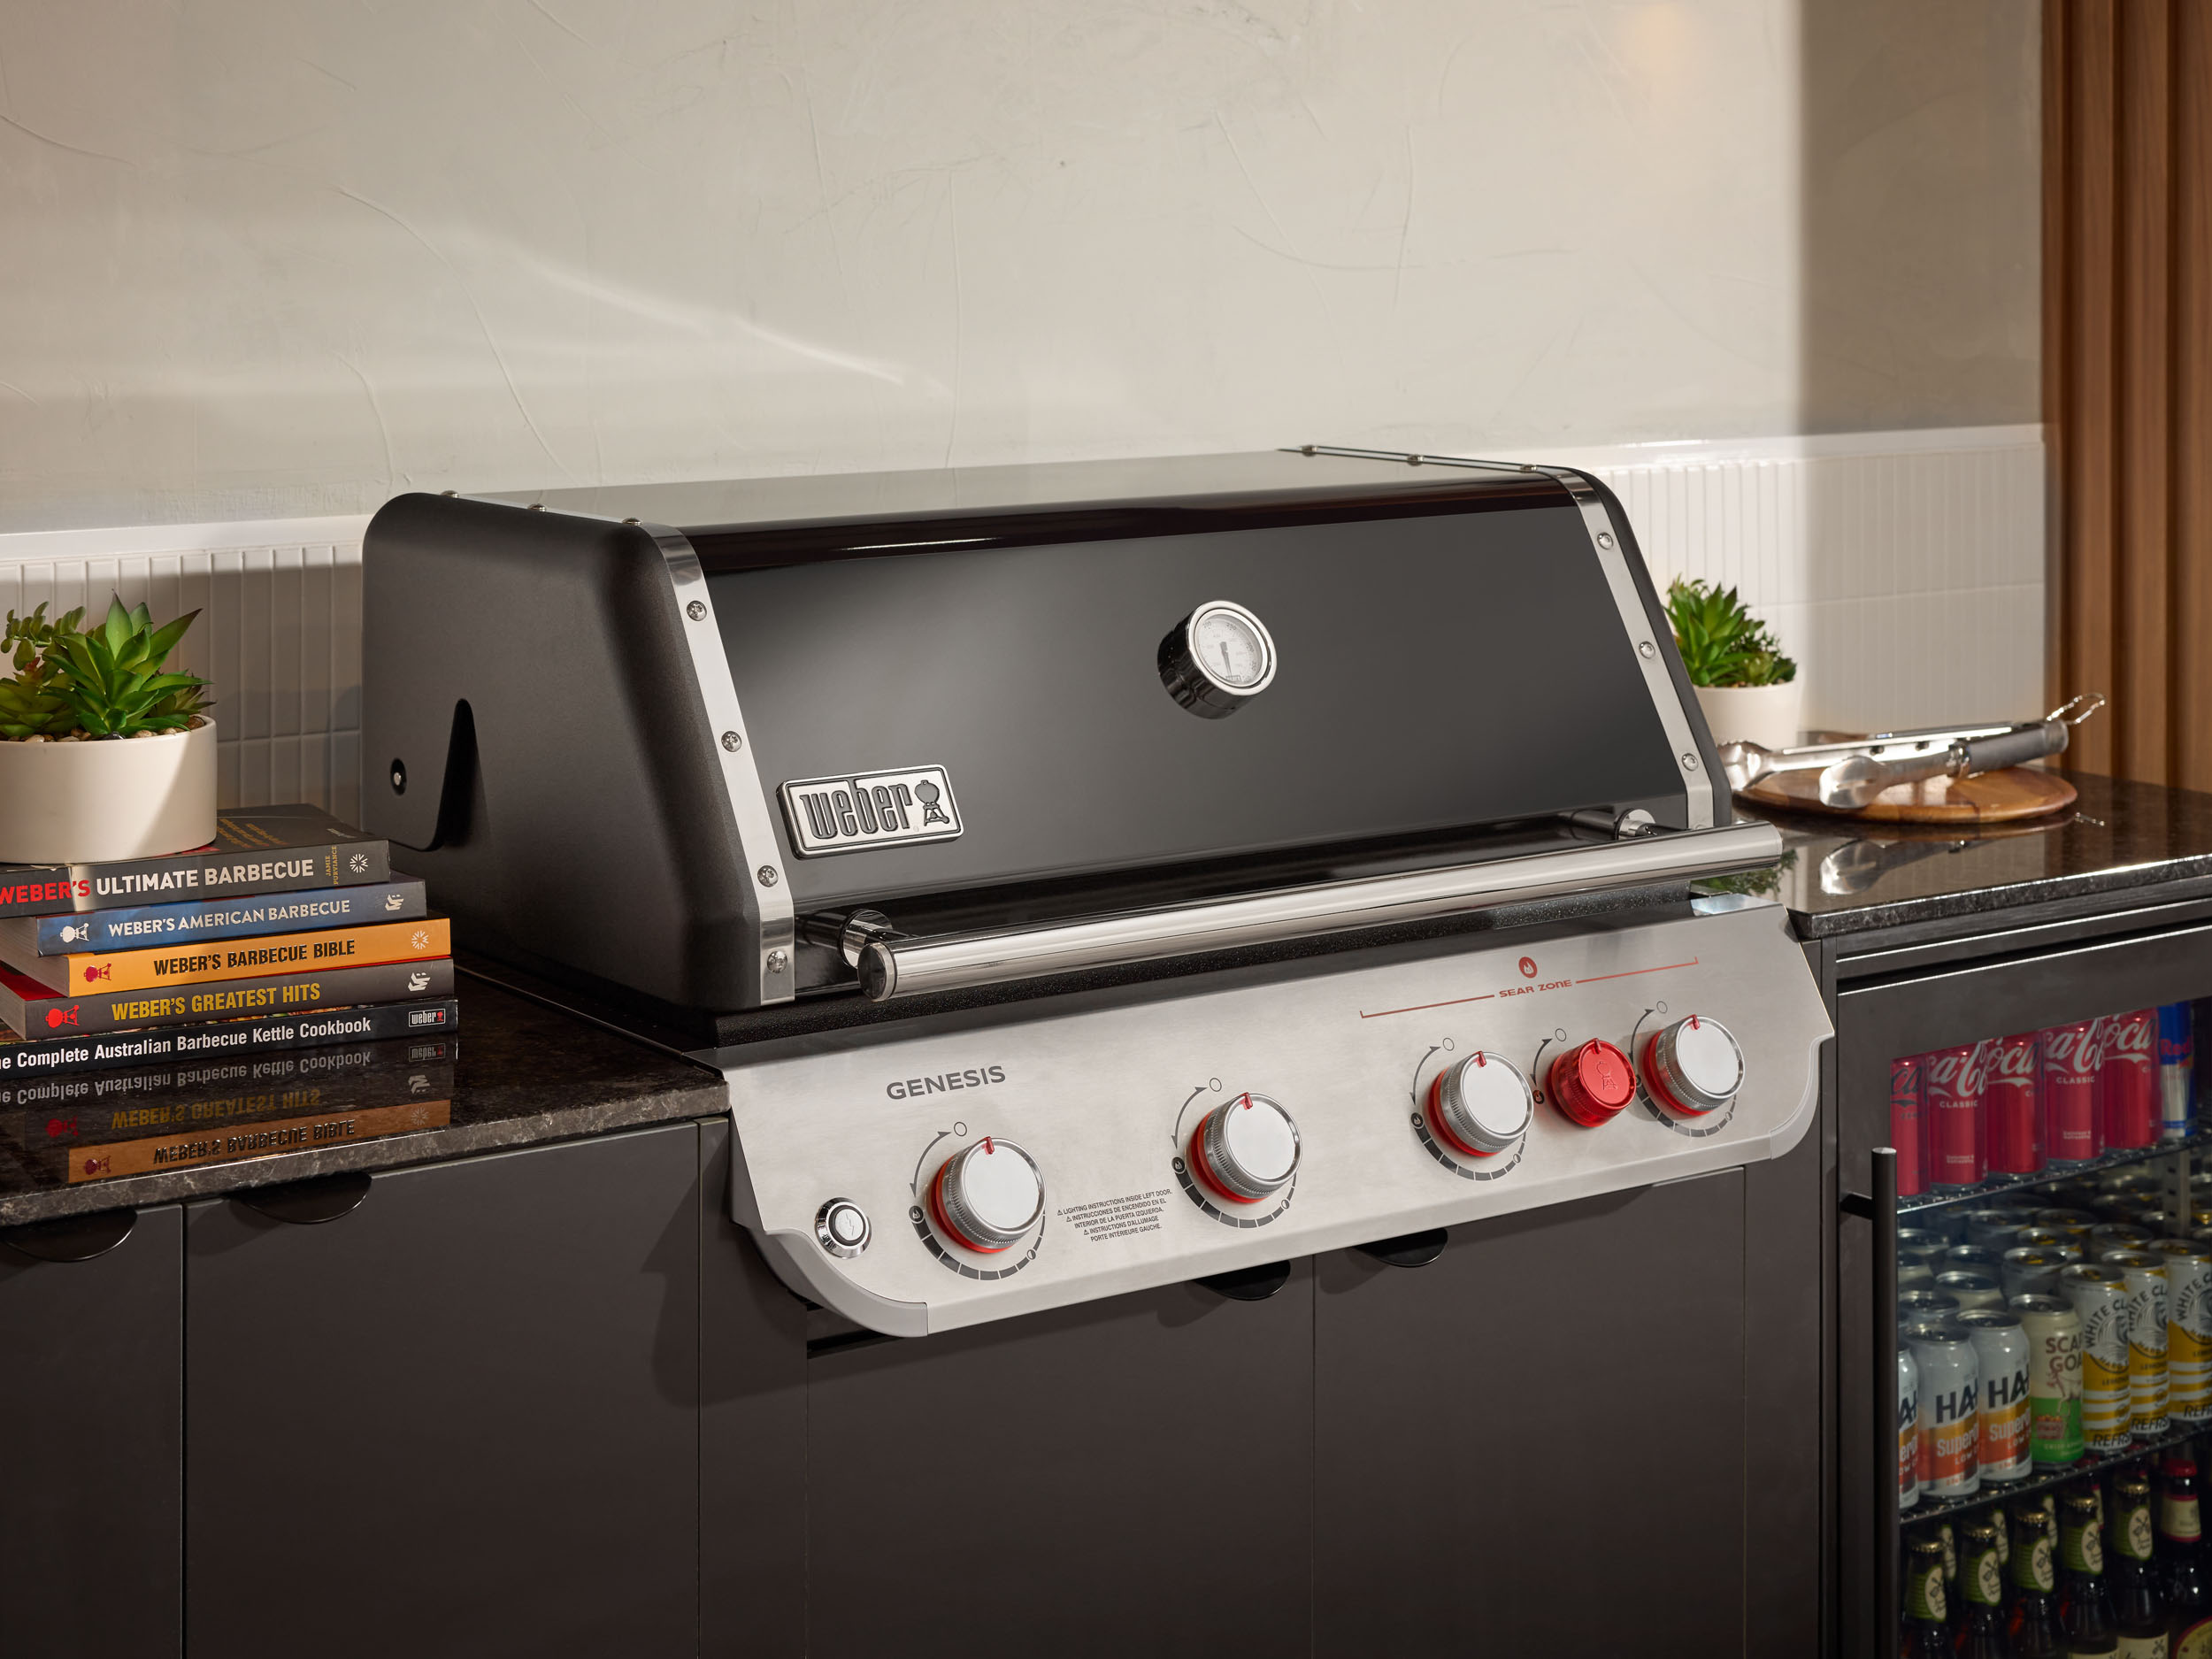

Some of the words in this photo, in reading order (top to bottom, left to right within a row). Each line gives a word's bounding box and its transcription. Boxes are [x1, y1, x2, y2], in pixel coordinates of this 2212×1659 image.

[799, 779, 913, 839] weber
[0, 879, 90, 905] WEBER'S
[96, 868, 199, 895] ULTIMATE
[205, 859, 313, 885] BARBECUE
[108, 918, 175, 937] WEBER'S
[178, 909, 264, 930] AMERICAN
[268, 899, 350, 921] BARBECUE
[154, 954, 221, 976] WEBER'S
[227, 945, 307, 968] BARBECUE
[313, 940, 355, 958] BIBLE
[112, 996, 185, 1021] WEBER'S
[191, 987, 276, 1013] GREATEST
[283, 982, 320, 1003] HITS
[1499, 986, 1534, 998] SEAR
[411, 1010, 436, 1025] weber
[18, 1047, 88, 1067] Complete
[95, 1039, 172, 1060] Australian
[177, 1032, 248, 1051] Barbecue
[253, 1025, 294, 1043] Kettle
[300, 1018, 372, 1037] Cookbook
[887, 1065, 1005, 1100] GENESIS
[2056, 1076, 2095, 1085] CLASSIC
[1939, 1100, 1978, 1109] CLASSIC
[1064, 1205, 1087, 1215] LIGHTING
[1088, 1198, 1125, 1209] INSTRUCTIONS
[1143, 1191, 1155, 1200] LEFT
[1072, 1207, 1113, 1221] INSTRUCCIONES
[1122, 1200, 1150, 1211] ENCENDIDO
[1074, 1218, 1099, 1228] INTERIOR
[1115, 1212, 1135, 1221] PUERTA
[1135, 1207, 1164, 1217] IZQUIERDA.
[1089, 1221, 1127, 1233] INSTRUCTIONS
[1127, 1216, 1159, 1226] D'ALLUMAGE
[1090, 1233, 1108, 1242] PORTE
[2176, 1278, 2202, 1322] WHITE
[2085, 1305, 2111, 1349] WHITE
